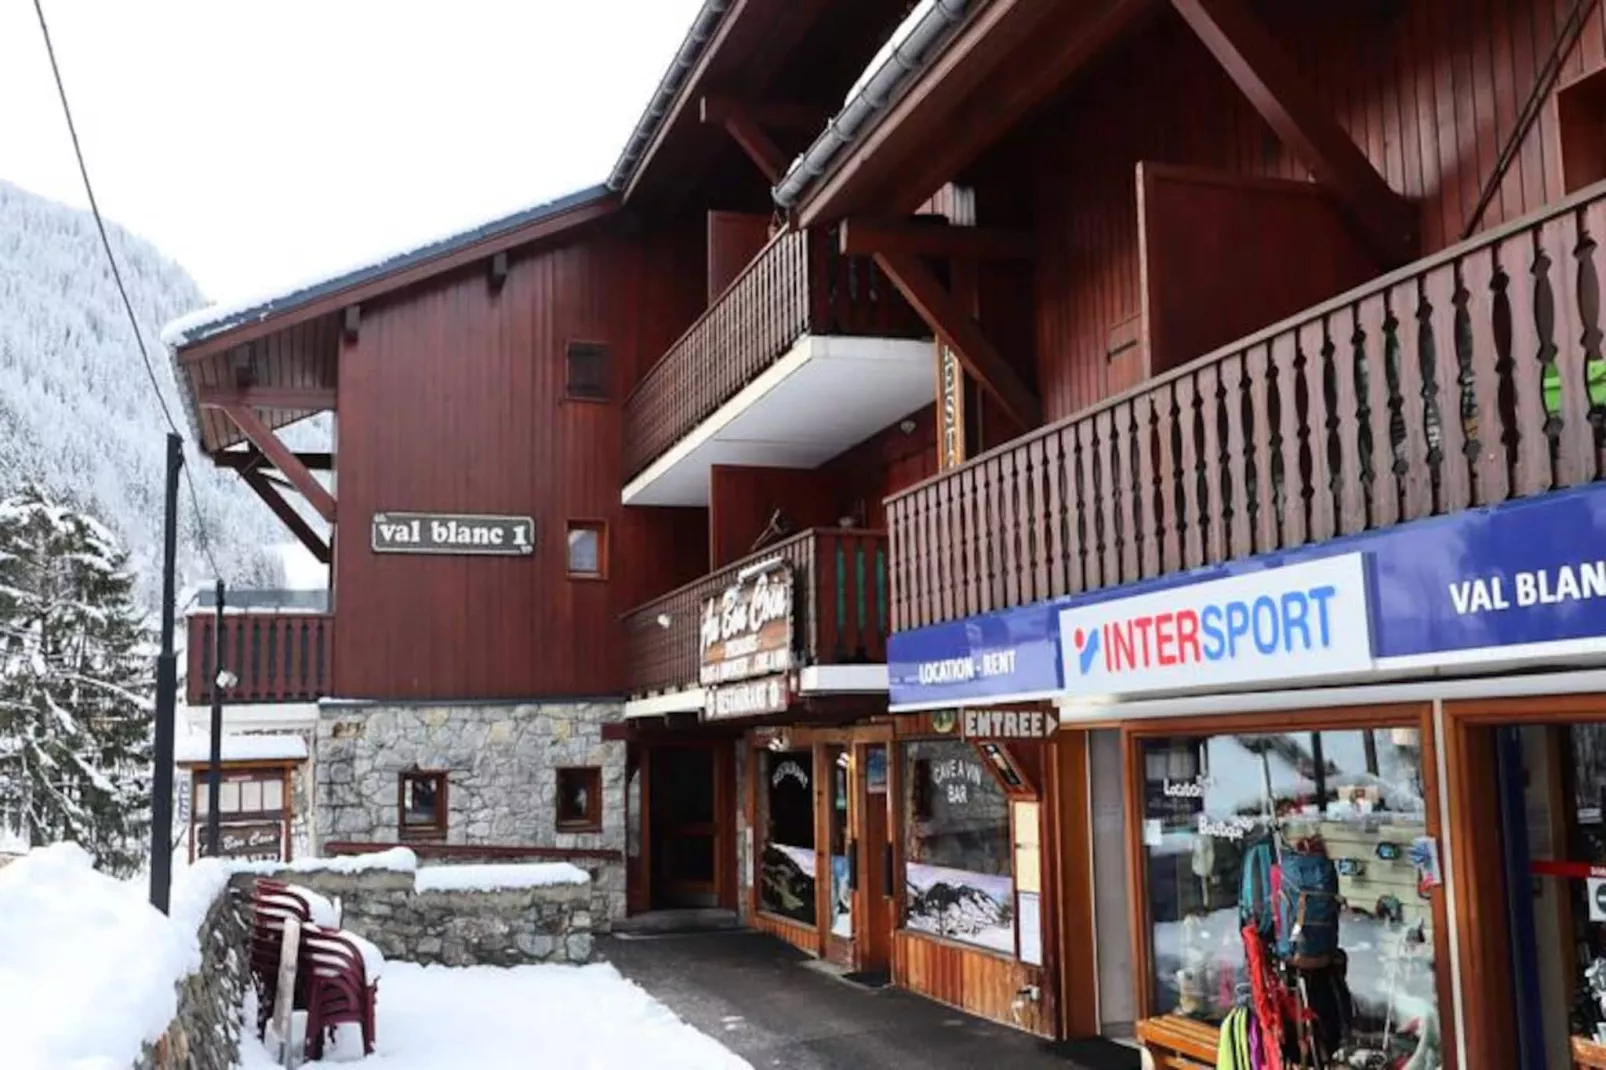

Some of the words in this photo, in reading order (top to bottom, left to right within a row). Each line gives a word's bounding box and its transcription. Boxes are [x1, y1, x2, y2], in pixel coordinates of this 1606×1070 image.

[379, 519, 421, 543] val
[431, 520, 505, 545] blanc
[513, 525, 527, 545] 1
[1449, 576, 1510, 615] VAL
[1515, 560, 1606, 608] BLAN
[1103, 585, 1337, 672] INTERSPORT
[918, 657, 975, 685] LOCATION
[983, 649, 1017, 676] RENT
[965, 709, 1043, 738] ENTREE
[947, 783, 969, 805] BAR
